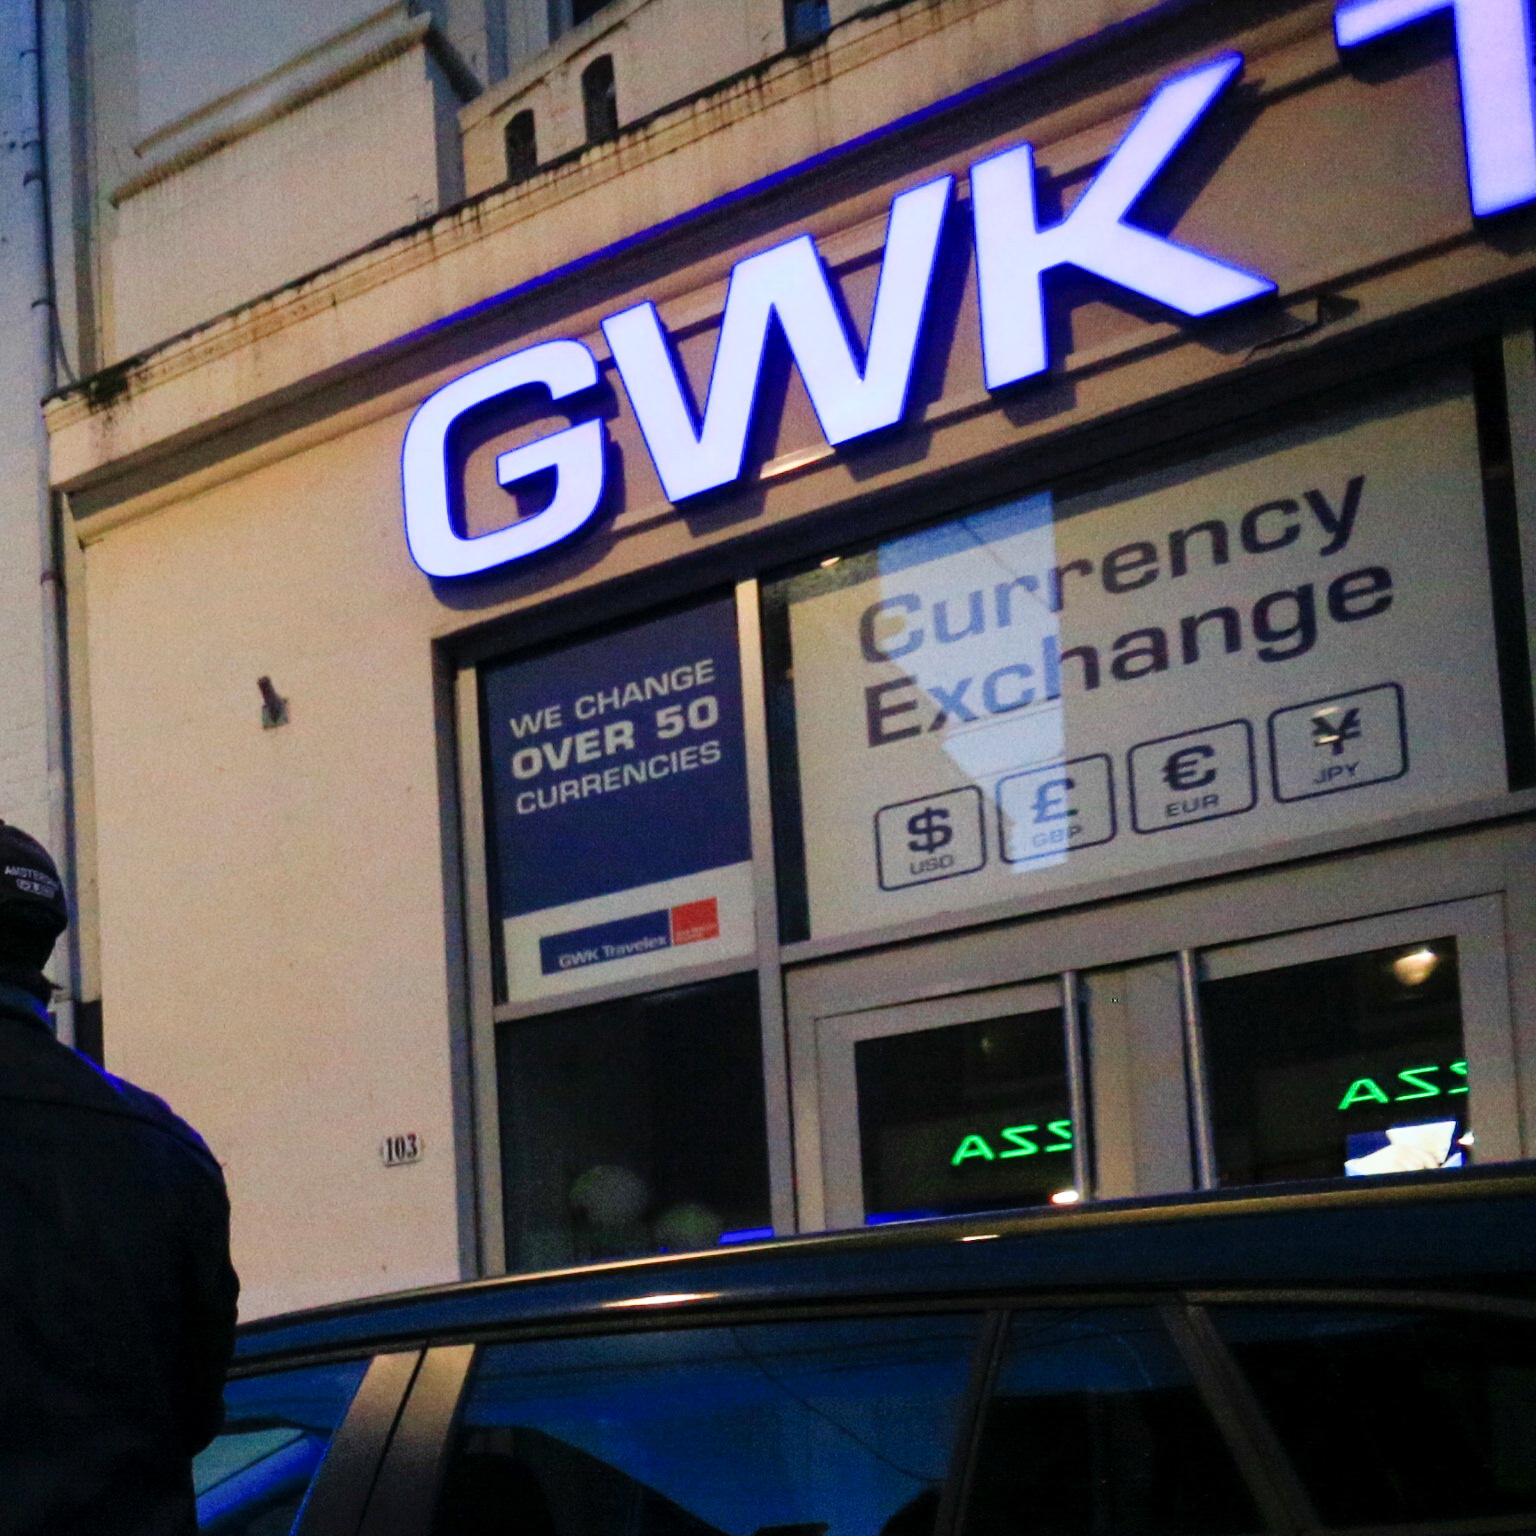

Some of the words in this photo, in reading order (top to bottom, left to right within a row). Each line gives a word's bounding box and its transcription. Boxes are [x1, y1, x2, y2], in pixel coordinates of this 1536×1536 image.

[401, 51, 1277, 579] GWK
[859, 474, 1367, 665] Currency
[863, 563, 1395, 748] Exchange
[509, 705, 563, 740] WE
[574, 657, 716, 721] CHANGE
[511, 719, 636, 781] OVER
[655, 695, 720, 740] 50
[515, 739, 723, 816] CURRENCIES
[1313, 761, 1361, 784] JPY
[1165, 793, 1221, 818] EUR
[1032, 825, 1083, 848] GBP
[909, 854, 956, 876] USD
[557, 947, 600, 969] GWK
[601, 934, 668, 958] Travelex
[386, 1132, 419, 1162] 103
